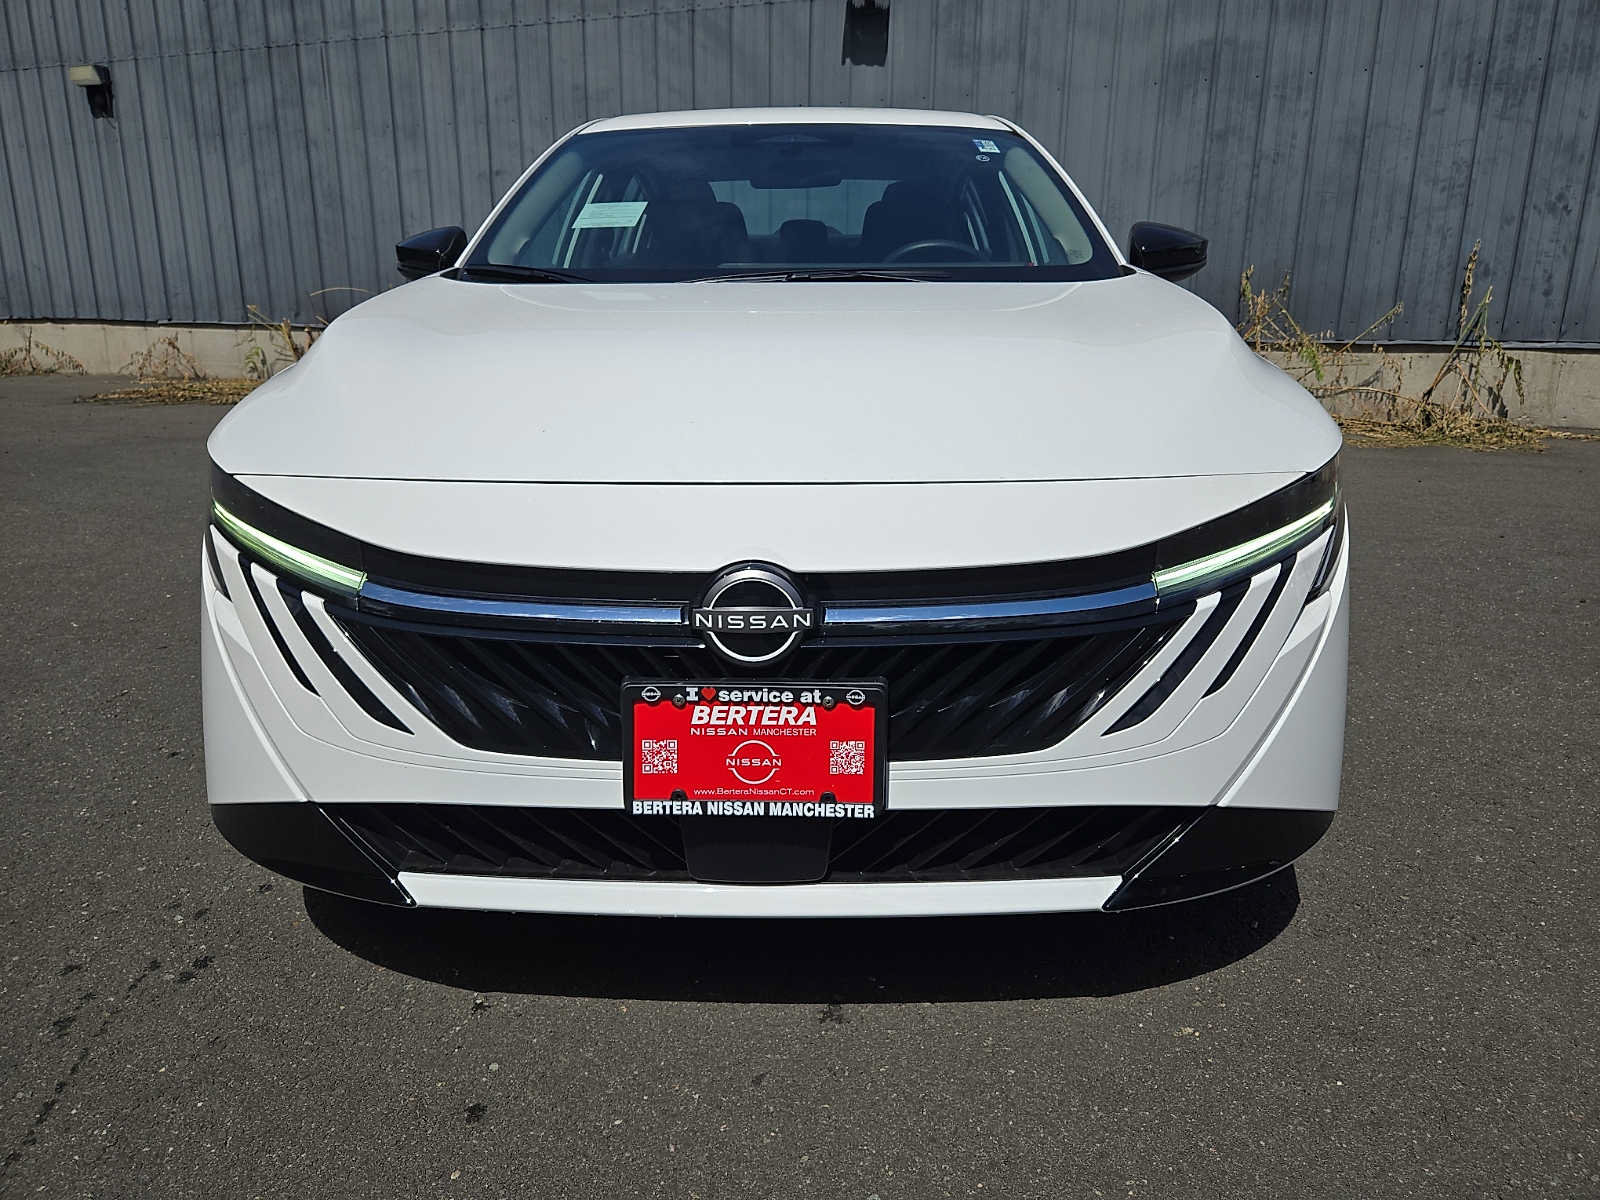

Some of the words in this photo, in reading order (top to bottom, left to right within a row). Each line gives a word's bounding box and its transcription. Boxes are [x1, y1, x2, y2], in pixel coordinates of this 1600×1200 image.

[695, 613, 811, 629] NISSAN
[686, 687, 698, 701] I
[718, 688, 793, 703] service
[800, 689, 821, 703] at
[691, 706, 817, 726] BERTERA
[690, 728, 748, 736] NISSAN
[753, 728, 817, 736] MANCHESTER
[725, 757, 782, 767] NISSAN
[693, 787, 815, 796] www.BerteraNissanCT.com
[633, 801, 702, 816] BERTERA
[707, 802, 765, 817] NISSAN
[769, 803, 875, 818] MANCHESTER
